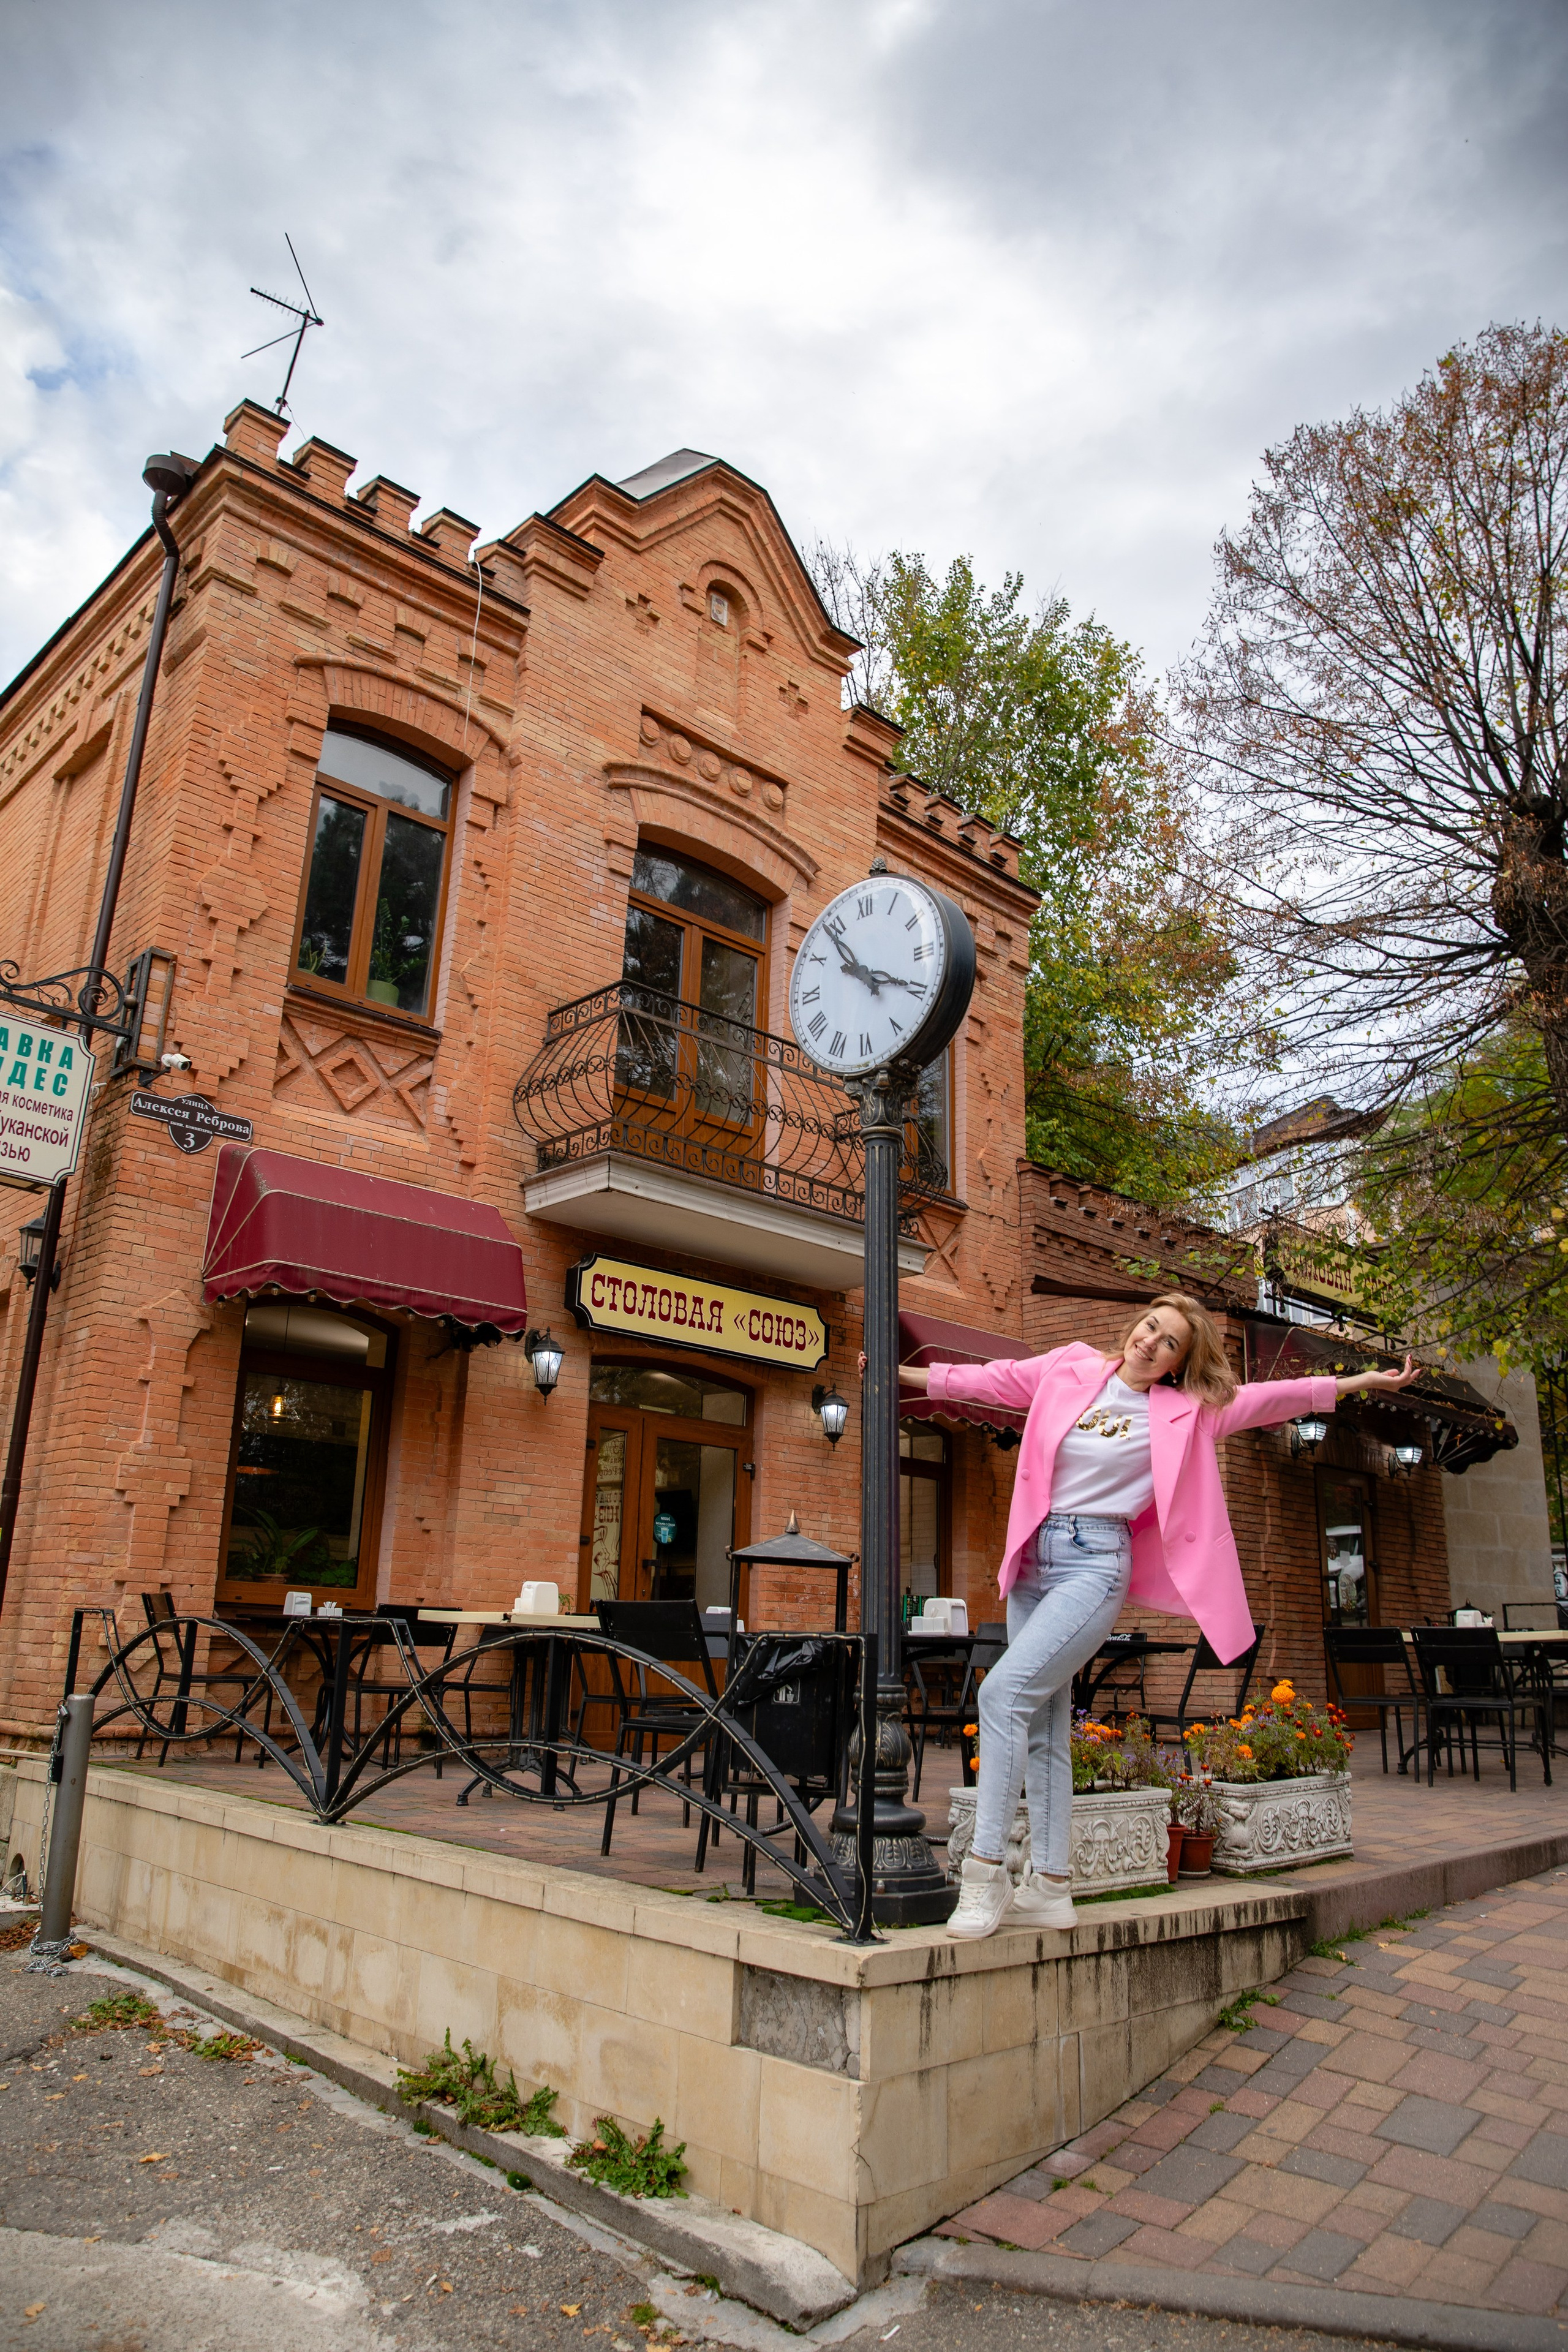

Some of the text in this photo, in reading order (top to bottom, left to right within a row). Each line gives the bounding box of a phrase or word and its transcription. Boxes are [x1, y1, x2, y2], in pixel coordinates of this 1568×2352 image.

[0, 1090, 74, 1122] я косметика
[133, 1097, 250, 1134] Алексея Реброва
[181, 1098, 209, 1110] УЛИЦА
[0, 1109, 70, 1148] уканской
[183, 1132, 195, 1148] 3
[0, 1140, 31, 1163] зью
[590, 1272, 821, 1351] СТОЛОВАЯ «СОЮЗ»
[1076, 1404, 1133, 1441] OUI
